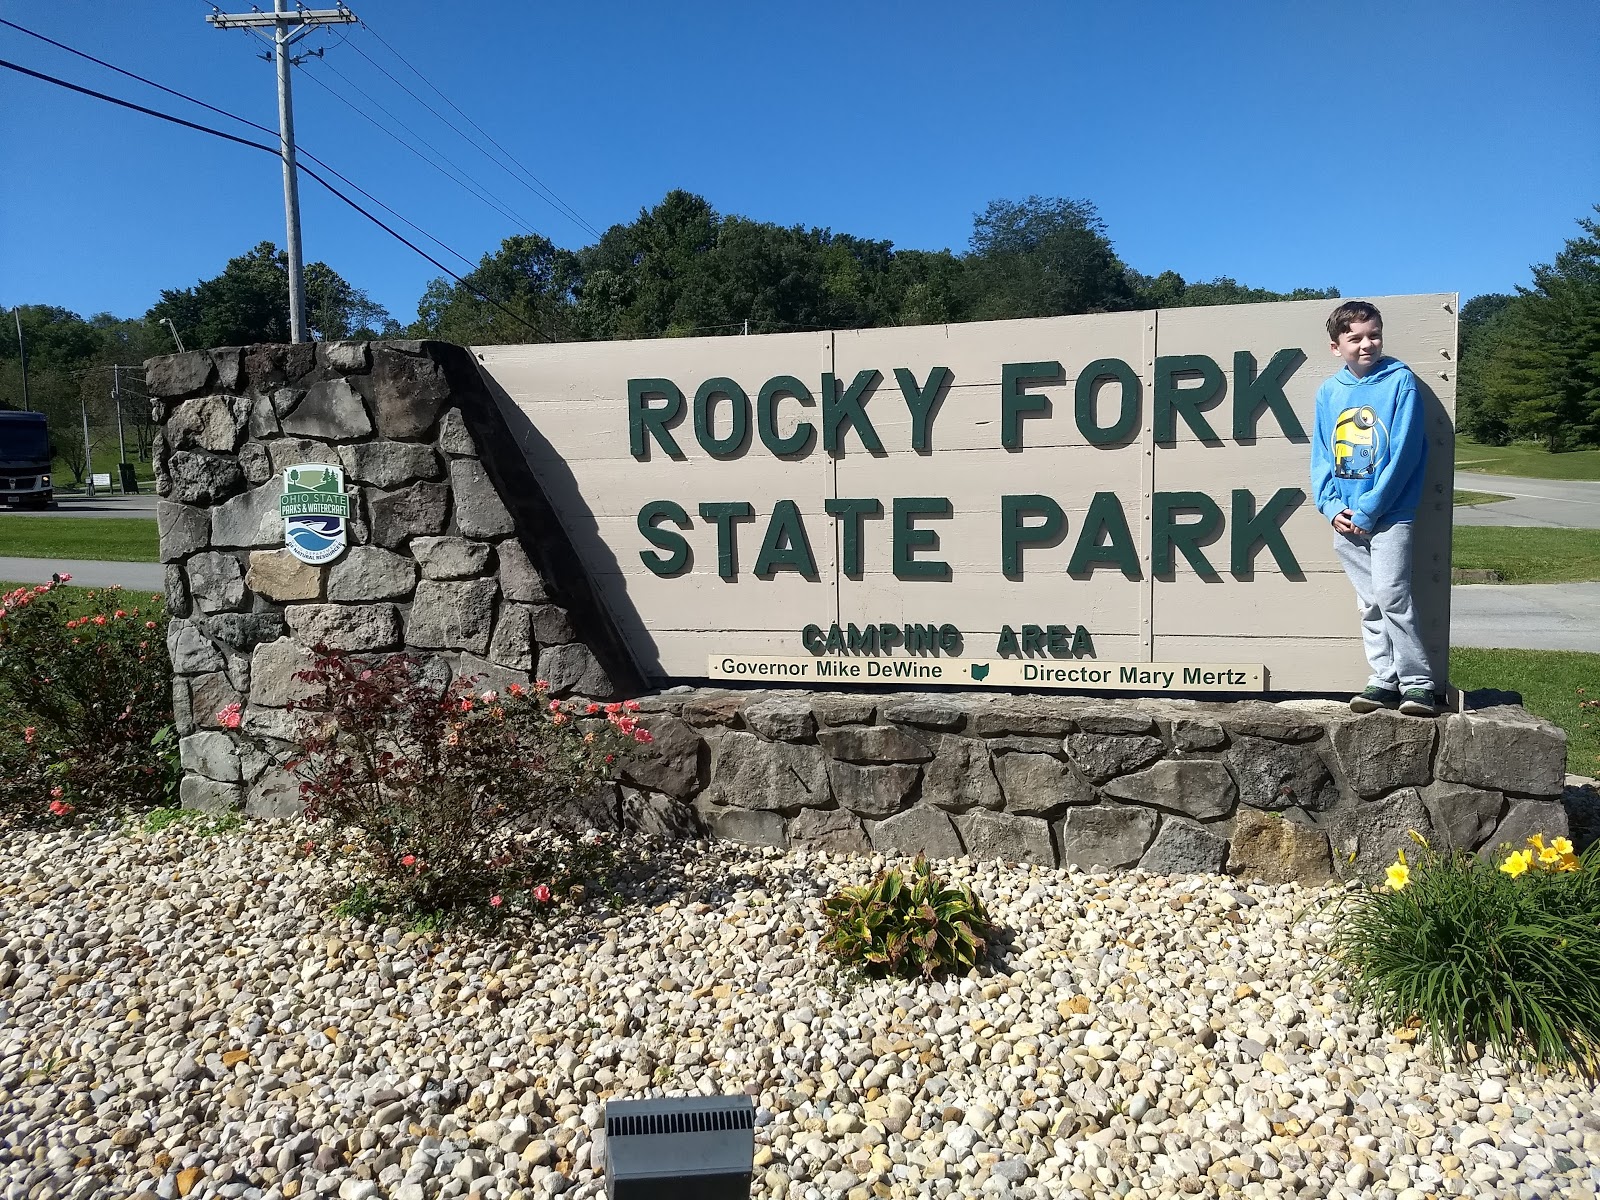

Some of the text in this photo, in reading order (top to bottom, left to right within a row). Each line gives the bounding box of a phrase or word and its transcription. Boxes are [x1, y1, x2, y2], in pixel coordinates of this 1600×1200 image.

[627, 348, 1307, 458] ROCKY FORK
[281, 494, 346, 505] OHIO STATE
[281, 503, 347, 516] PARKS & WATERCRAFT
[637, 488, 1305, 581] STATE PARK
[293, 547, 315, 560] NATURAL
[802, 622, 1094, 654] CAMPING AREA
[721, 658, 943, 678] Governor Mike DeWine
[1023, 664, 1248, 689] Director Mary Mertz
